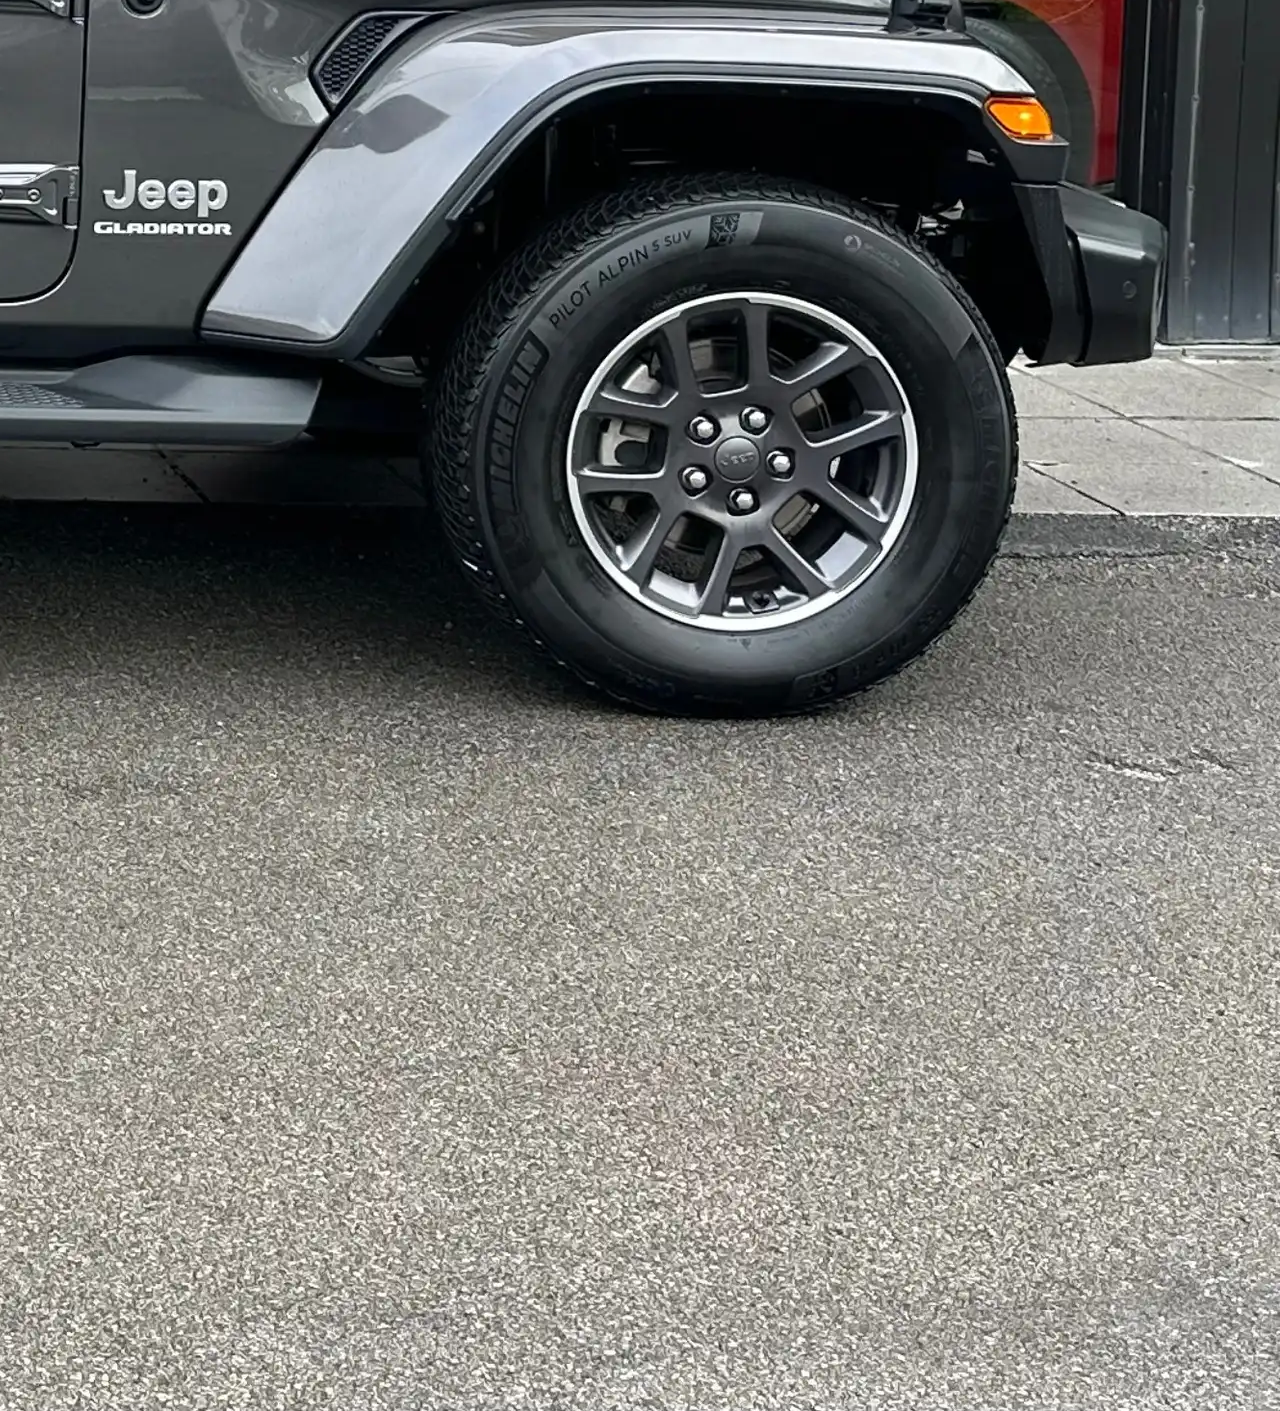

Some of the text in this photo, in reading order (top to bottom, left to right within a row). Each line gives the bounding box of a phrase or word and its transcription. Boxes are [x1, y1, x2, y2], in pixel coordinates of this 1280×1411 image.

[102, 169, 229, 218] Jeep
[93, 221, 232, 236] GLADIATOR
[490, 340, 542, 514] MICHELIN
[548, 281, 593, 329] PILOT
[597, 245, 650, 287] ALPIN
[663, 230, 693, 248] SUV
